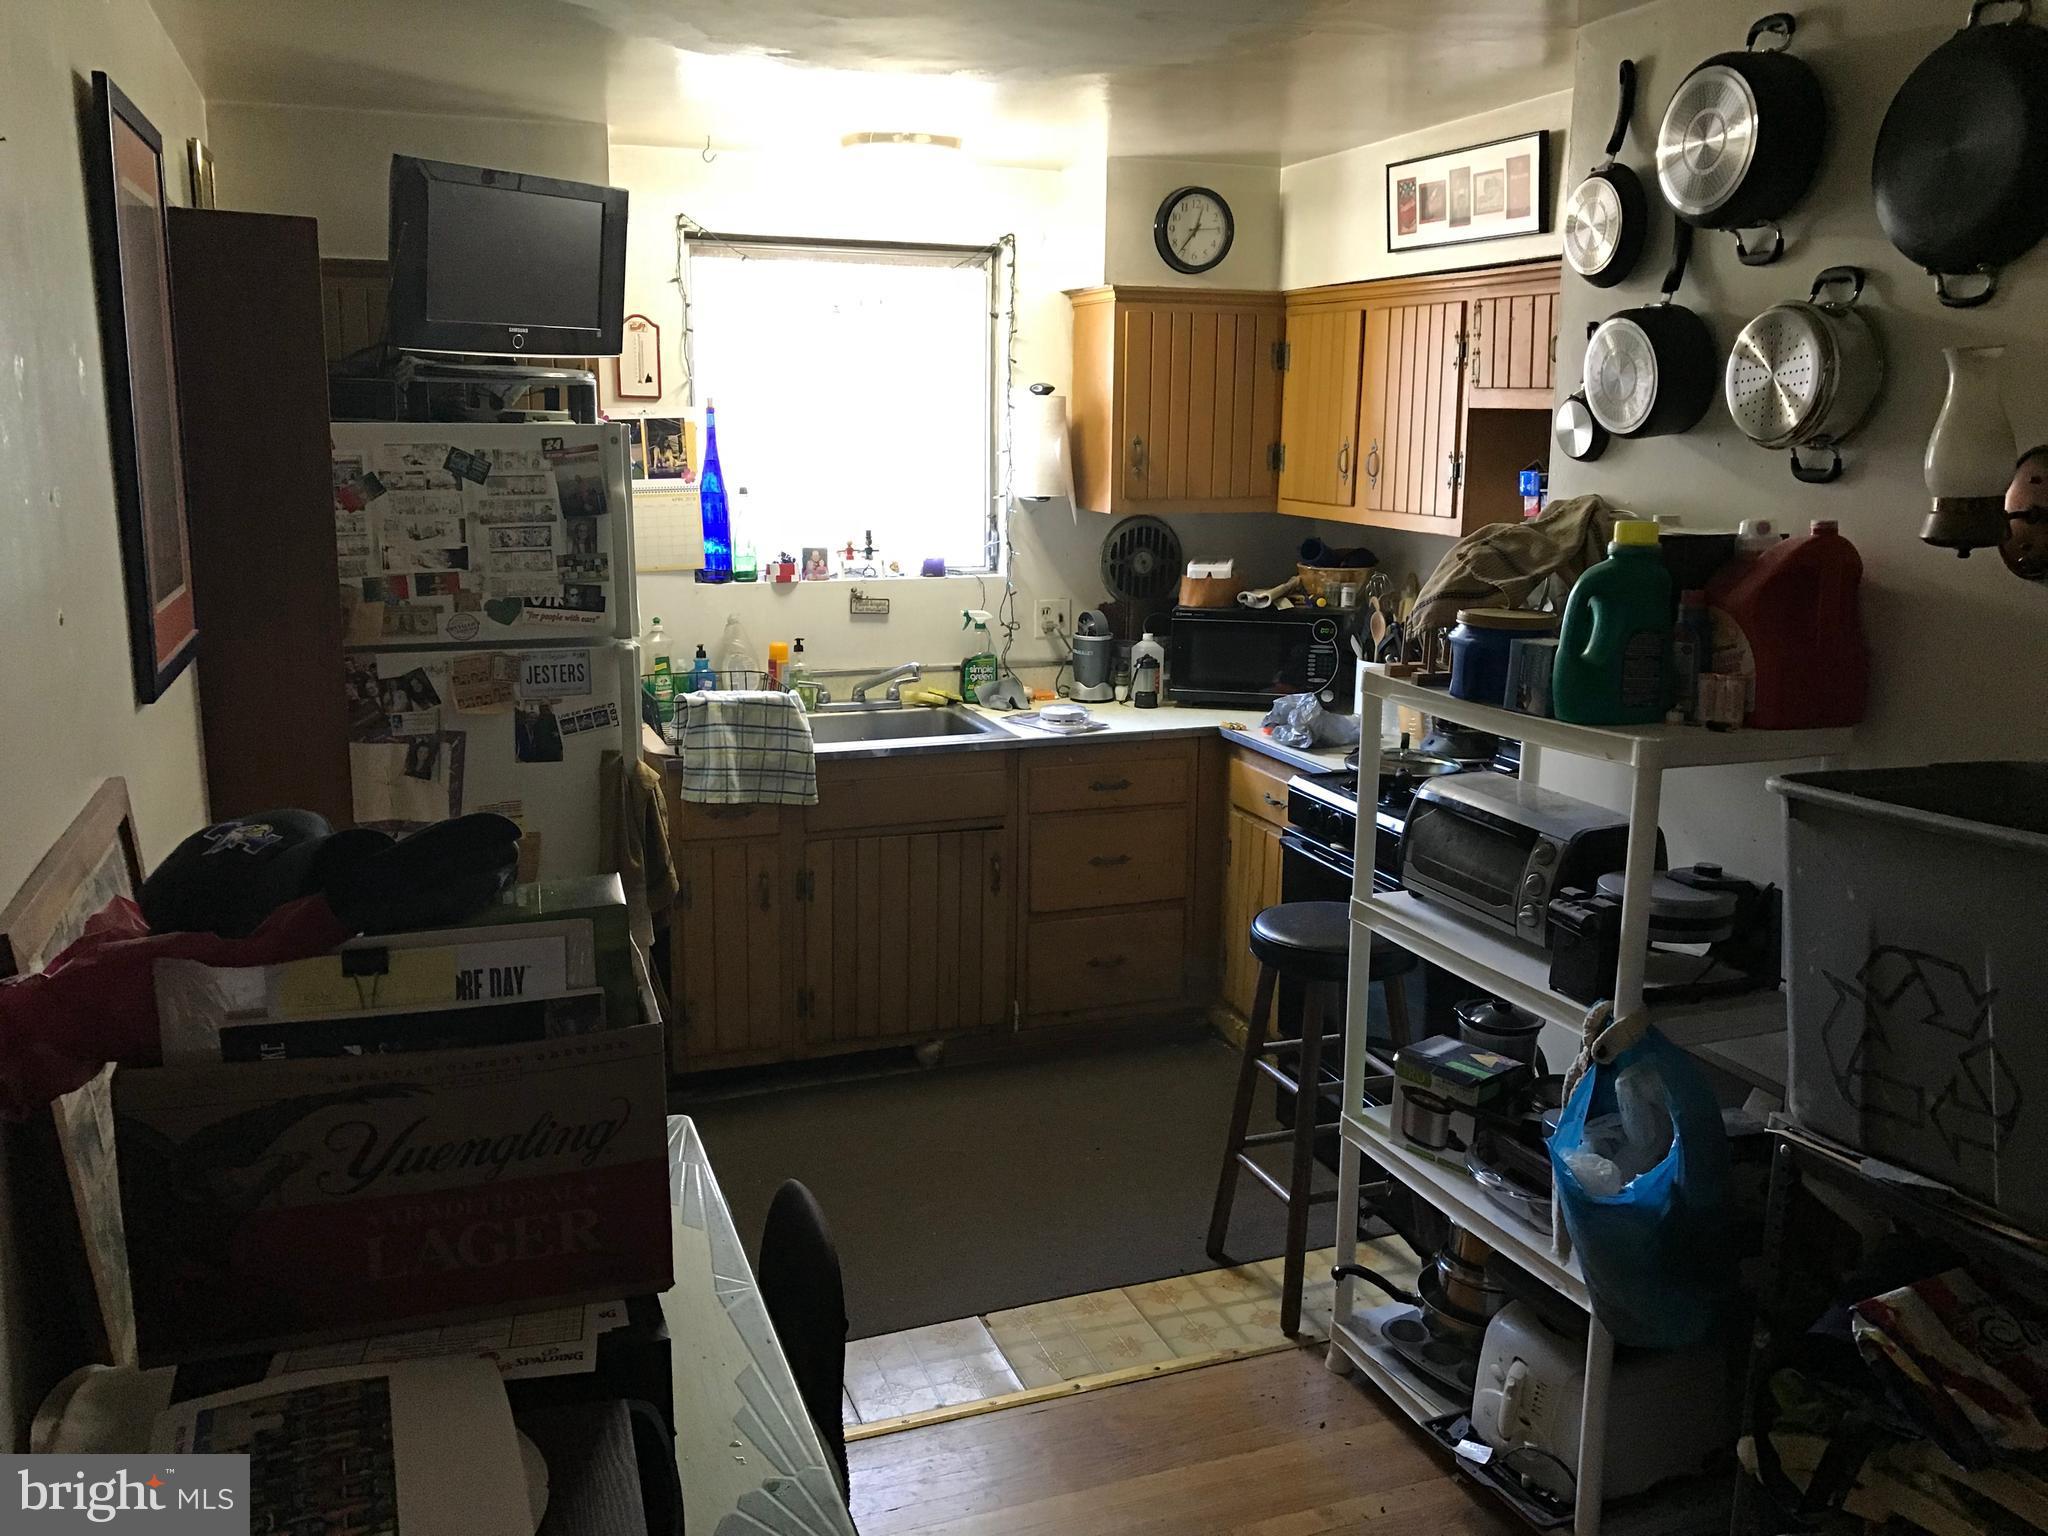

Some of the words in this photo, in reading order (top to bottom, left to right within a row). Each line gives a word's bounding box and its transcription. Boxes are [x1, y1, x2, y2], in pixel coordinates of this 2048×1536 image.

[540, 613, 562, 622] people
[564, 614, 580, 622] with
[526, 663, 585, 684] JESTERS
[969, 664, 994, 674] simple
[969, 673, 994, 683] green
[490, 965, 525, 998] DAY
[316, 1098, 632, 1196] Yuengling
[367, 1207, 608, 1281] LAGER
[515, 1351, 584, 1367] SPALDING
